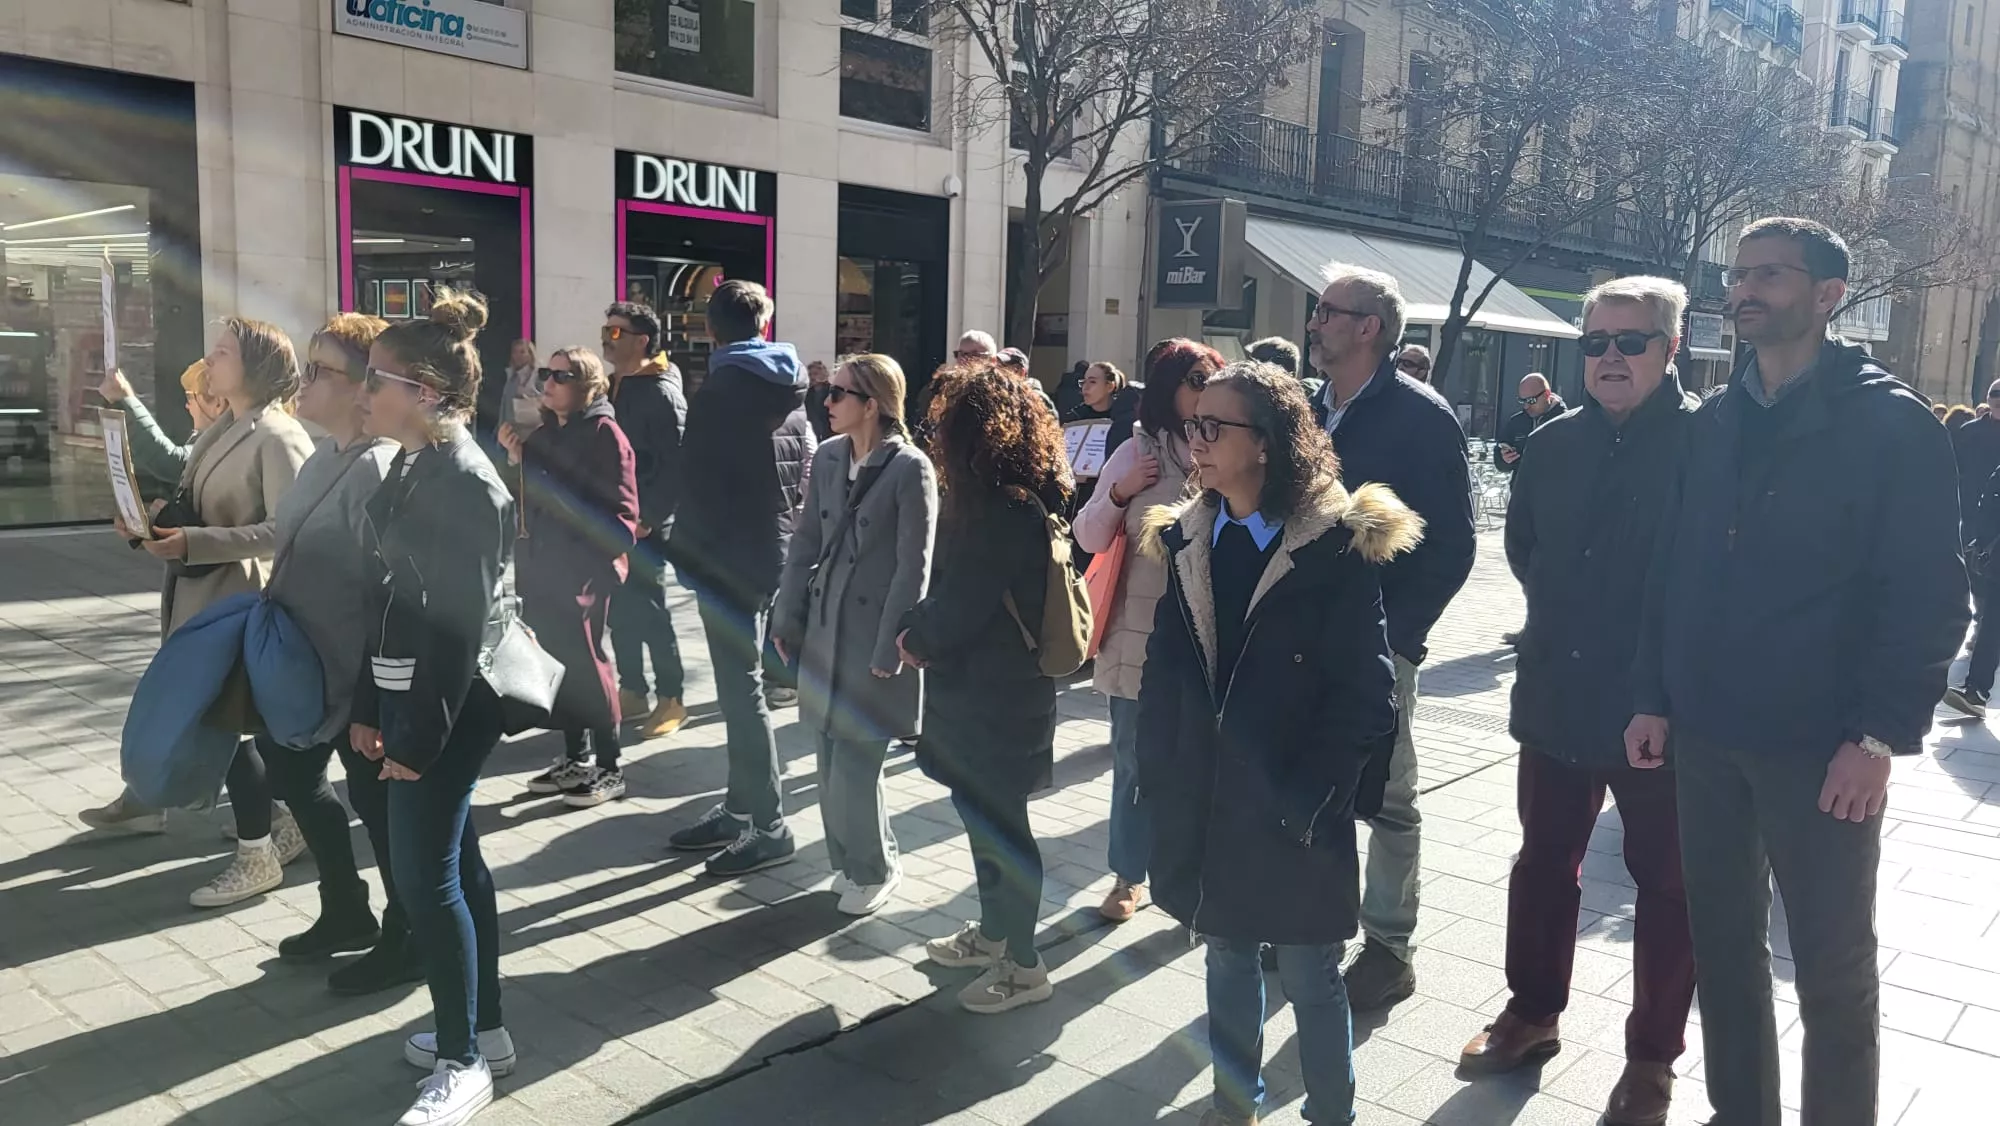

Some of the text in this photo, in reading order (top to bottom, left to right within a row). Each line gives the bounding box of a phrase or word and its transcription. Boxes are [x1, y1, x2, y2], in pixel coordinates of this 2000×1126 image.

[425, 33, 465, 48] INTEGRAL
[349, 111, 516, 182] DRUNI
[633, 154, 756, 212] DRUNI
[1166, 266, 1206, 284] miBar
